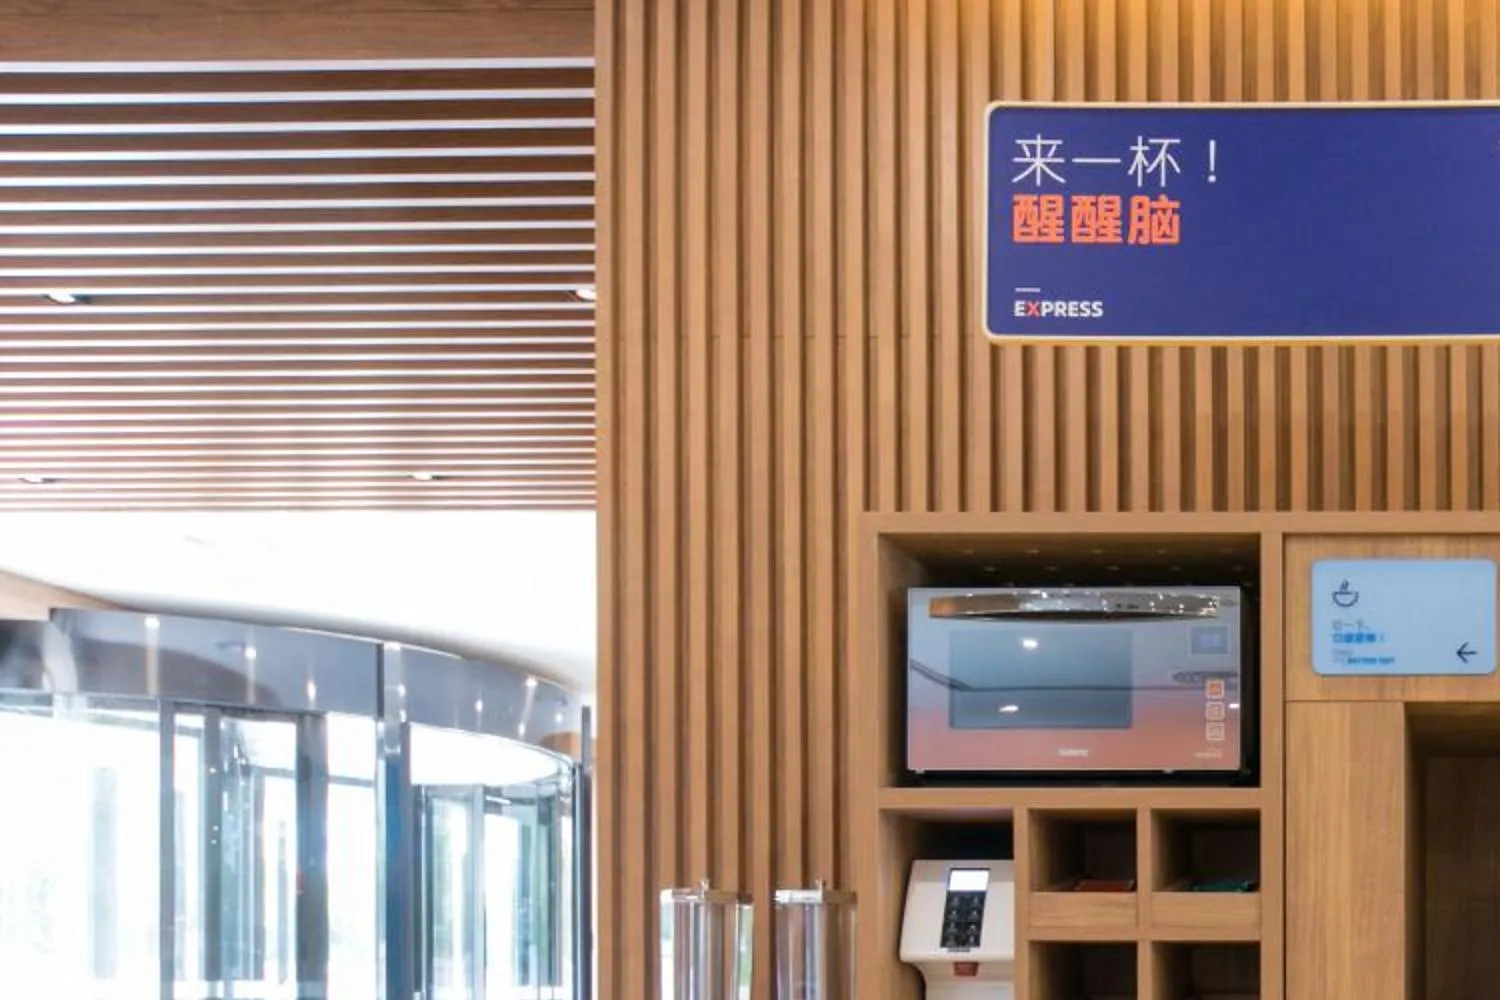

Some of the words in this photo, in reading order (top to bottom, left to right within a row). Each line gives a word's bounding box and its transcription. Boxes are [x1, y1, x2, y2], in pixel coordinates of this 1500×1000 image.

[1011, 133, 1218, 187] 来一杯！
[1012, 194, 1181, 245] 醒醒脑
[1014, 300, 1103, 317] EXPRESS
